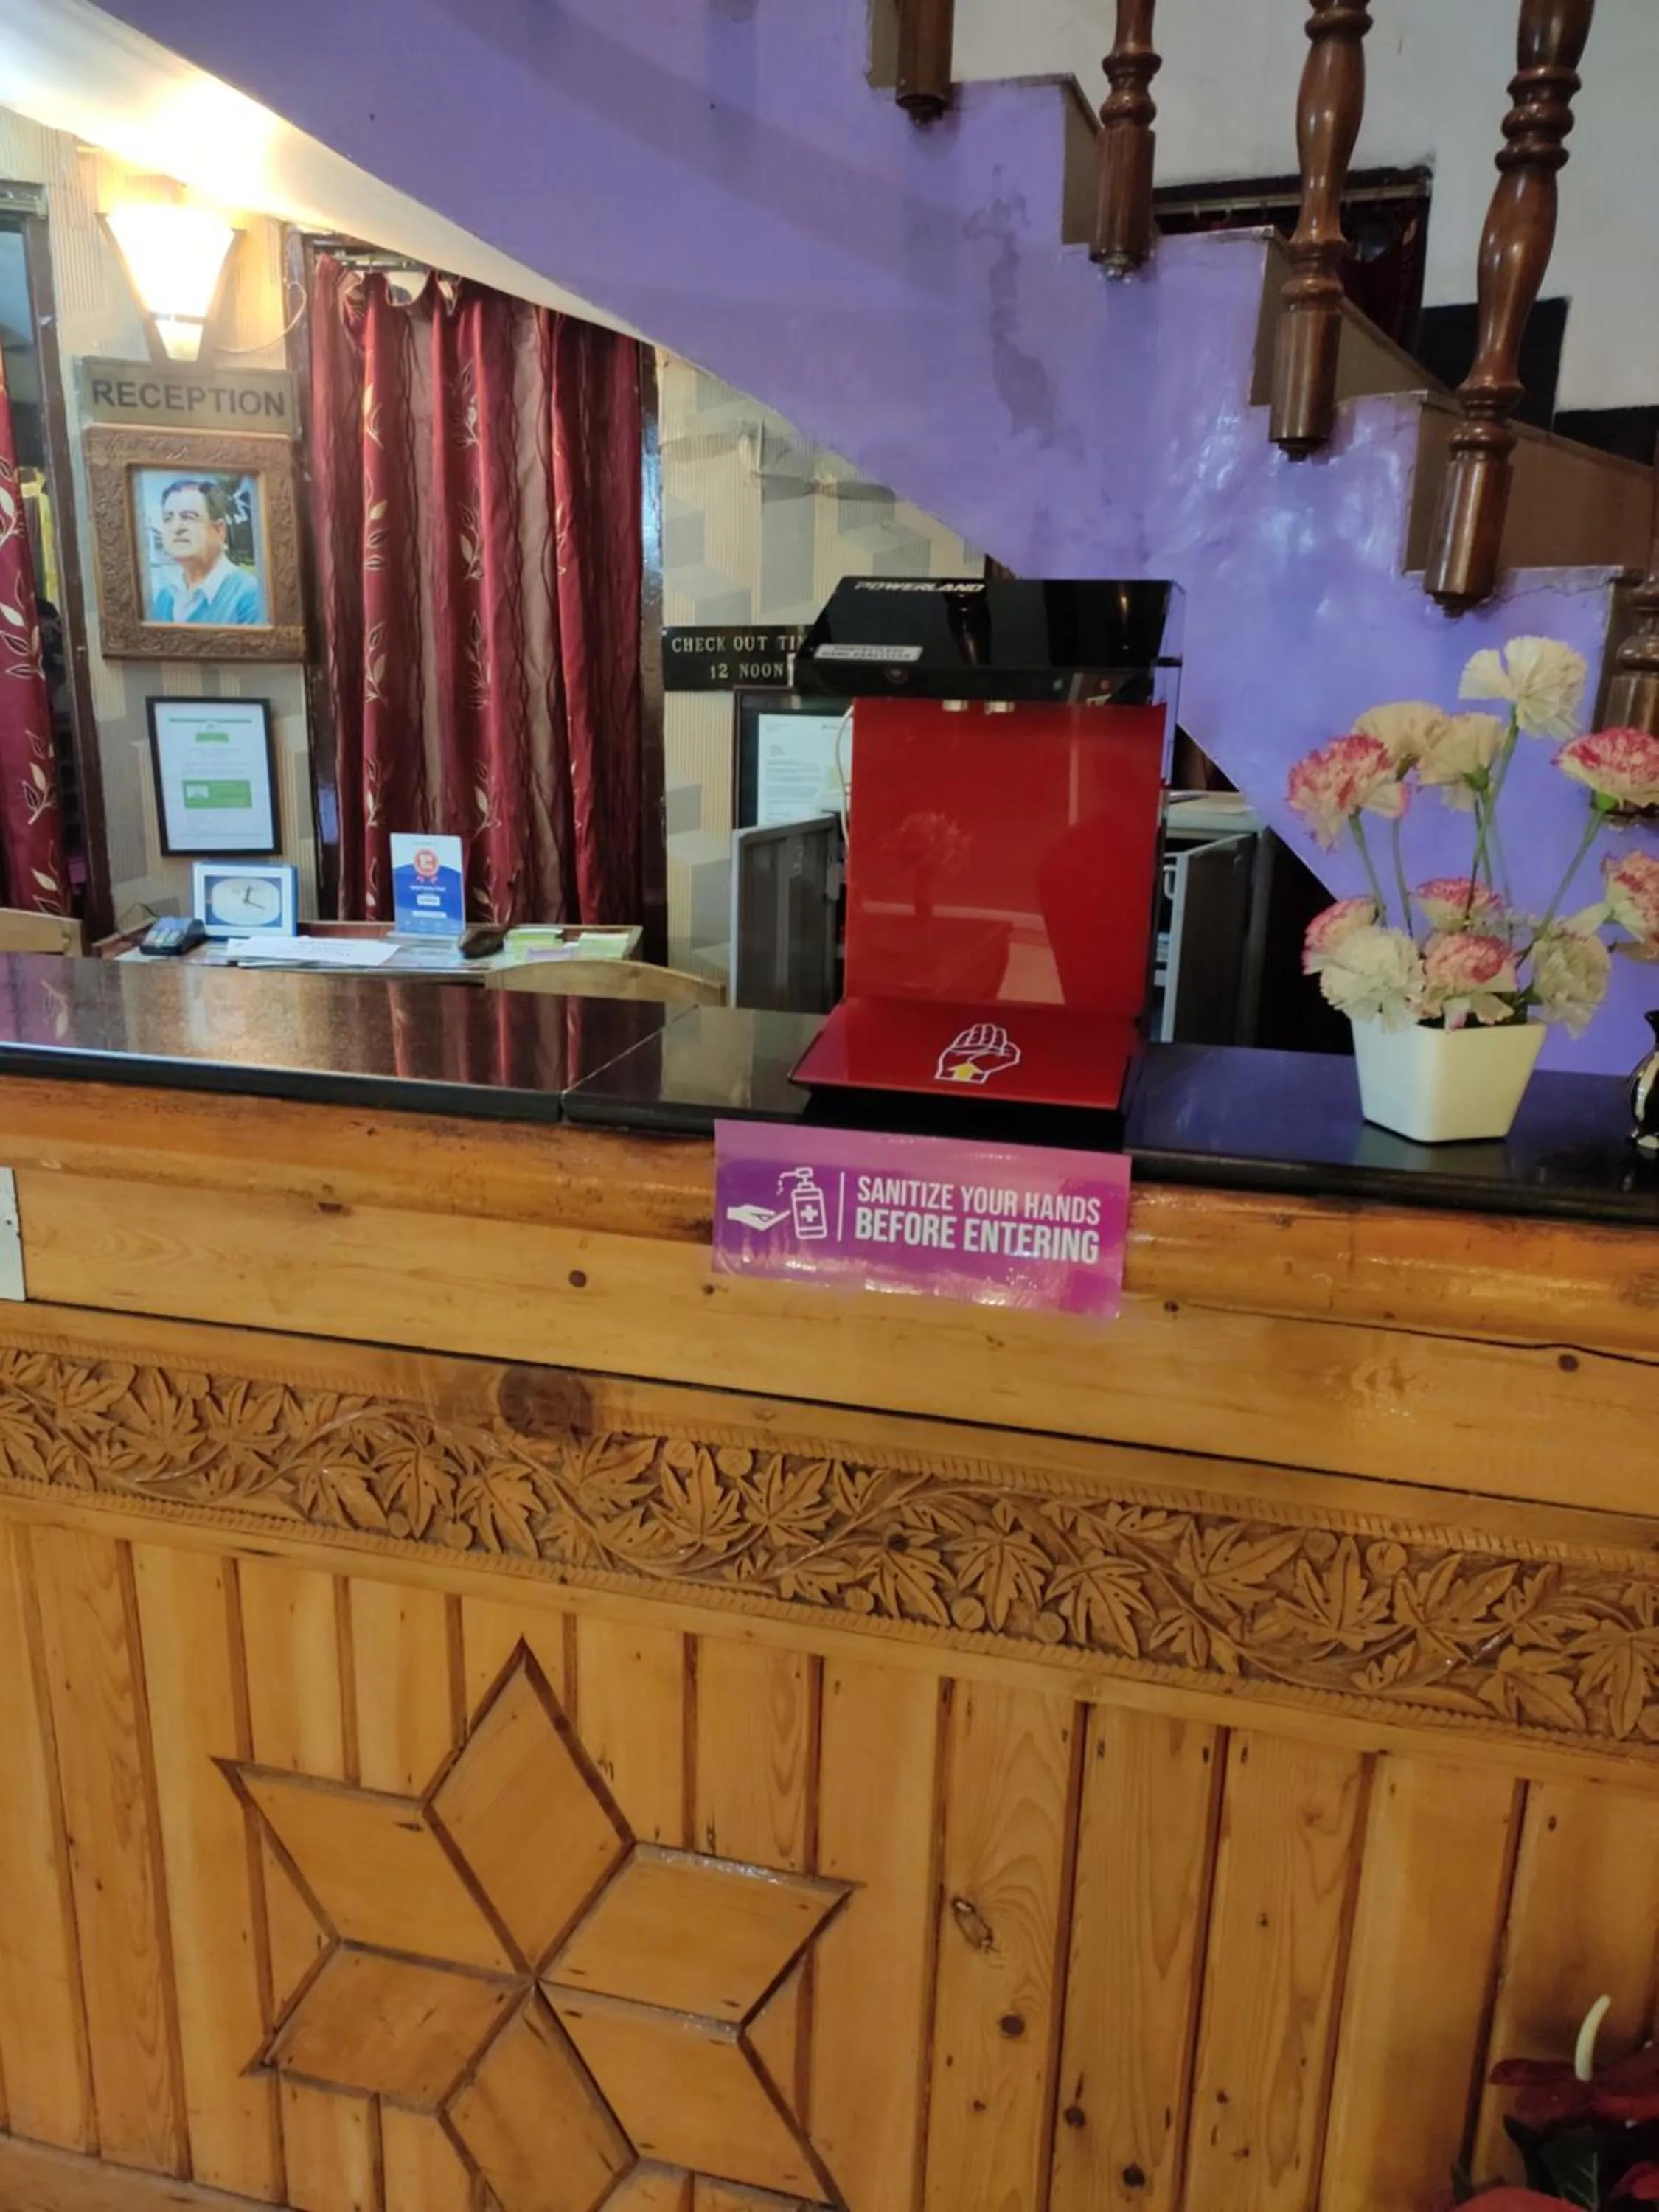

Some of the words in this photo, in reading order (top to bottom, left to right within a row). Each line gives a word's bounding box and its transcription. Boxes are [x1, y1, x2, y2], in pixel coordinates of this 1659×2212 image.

[91, 379, 285, 417] RECEPTION
[672, 636, 726, 653] CHECK
[733, 635, 768, 652] OUT
[710, 664, 729, 679] 12
[739, 662, 785, 678] NOON
[857, 1175, 953, 1211] SANITIZE
[961, 1186, 1017, 1217] YOUR
[1024, 1193, 1101, 1226] HANDS
[855, 1206, 956, 1249] BEFORE
[963, 1220, 1099, 1265] ENTERING
